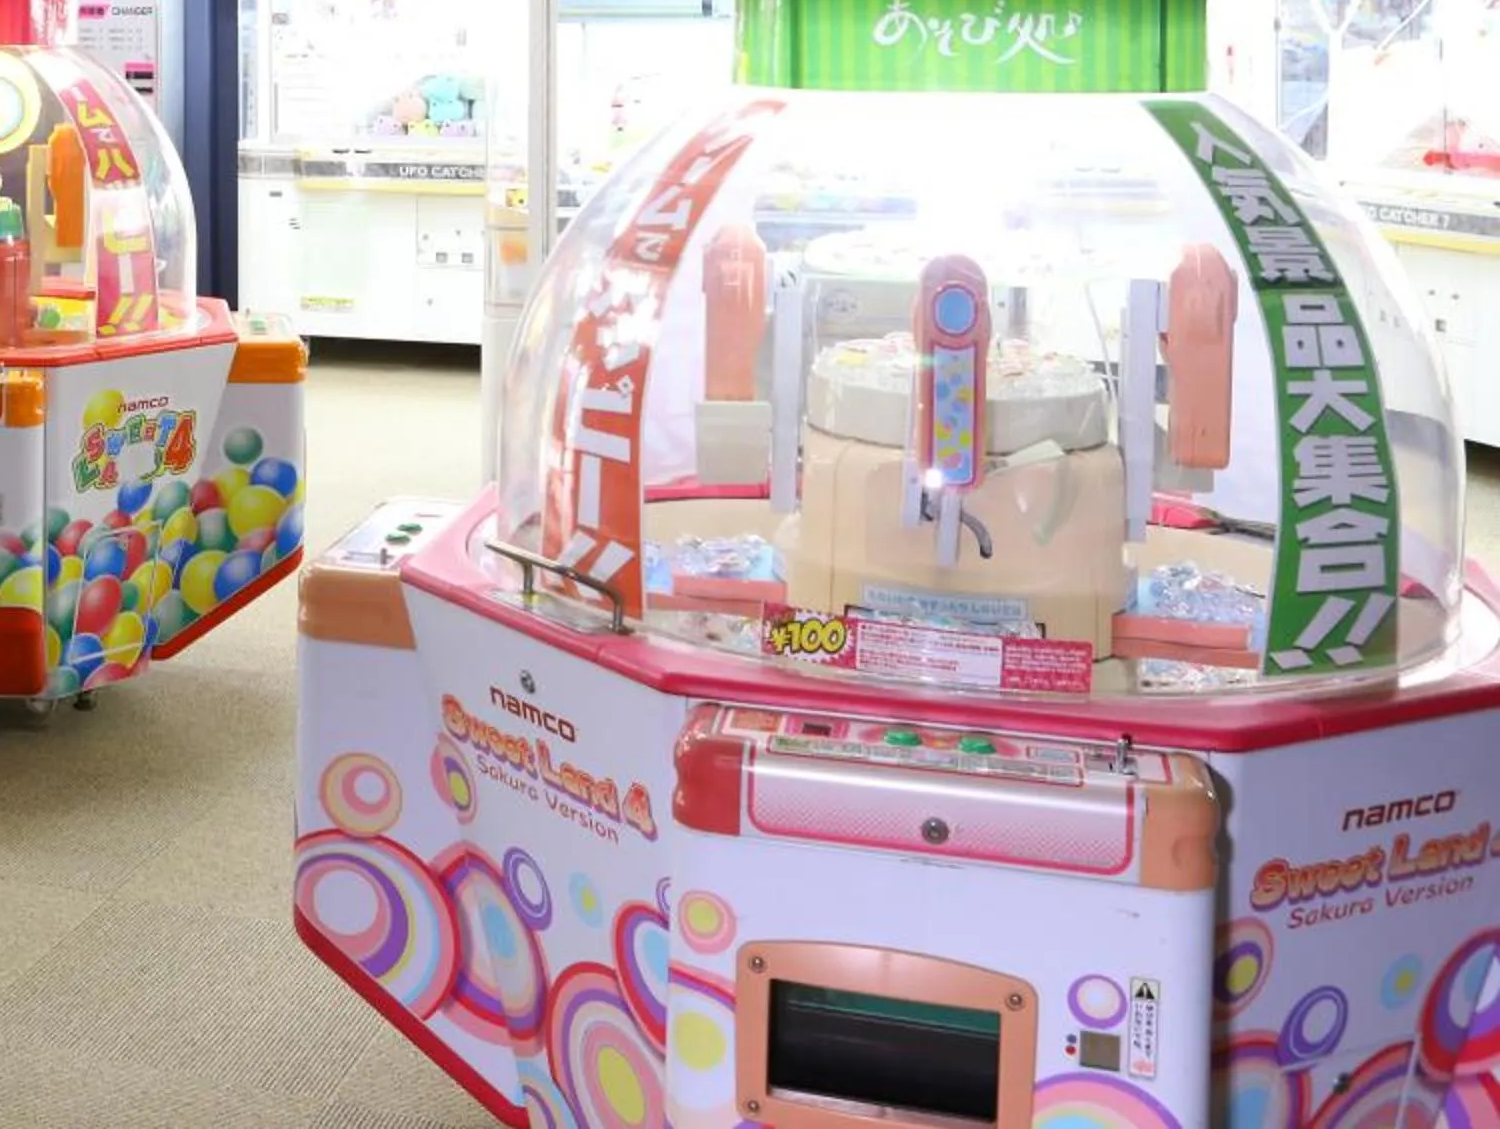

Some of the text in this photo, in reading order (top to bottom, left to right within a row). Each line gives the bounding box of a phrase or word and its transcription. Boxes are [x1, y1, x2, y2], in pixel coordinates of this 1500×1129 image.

[399, 166, 428, 178] UFO
[117, 396, 169, 414] namco
[162, 411, 196, 474] 4
[770, 618, 847, 655] ¥100
[489, 685, 577, 743] namco
[442, 694, 658, 842] Sweet Land 4
[476, 754, 619, 845] Sakura Version
[1342, 789, 1457, 832] namco
[1250, 846, 1385, 912] Sweet
[1387, 822, 1491, 883] Land
[1287, 875, 1475, 929] Sakura Version
